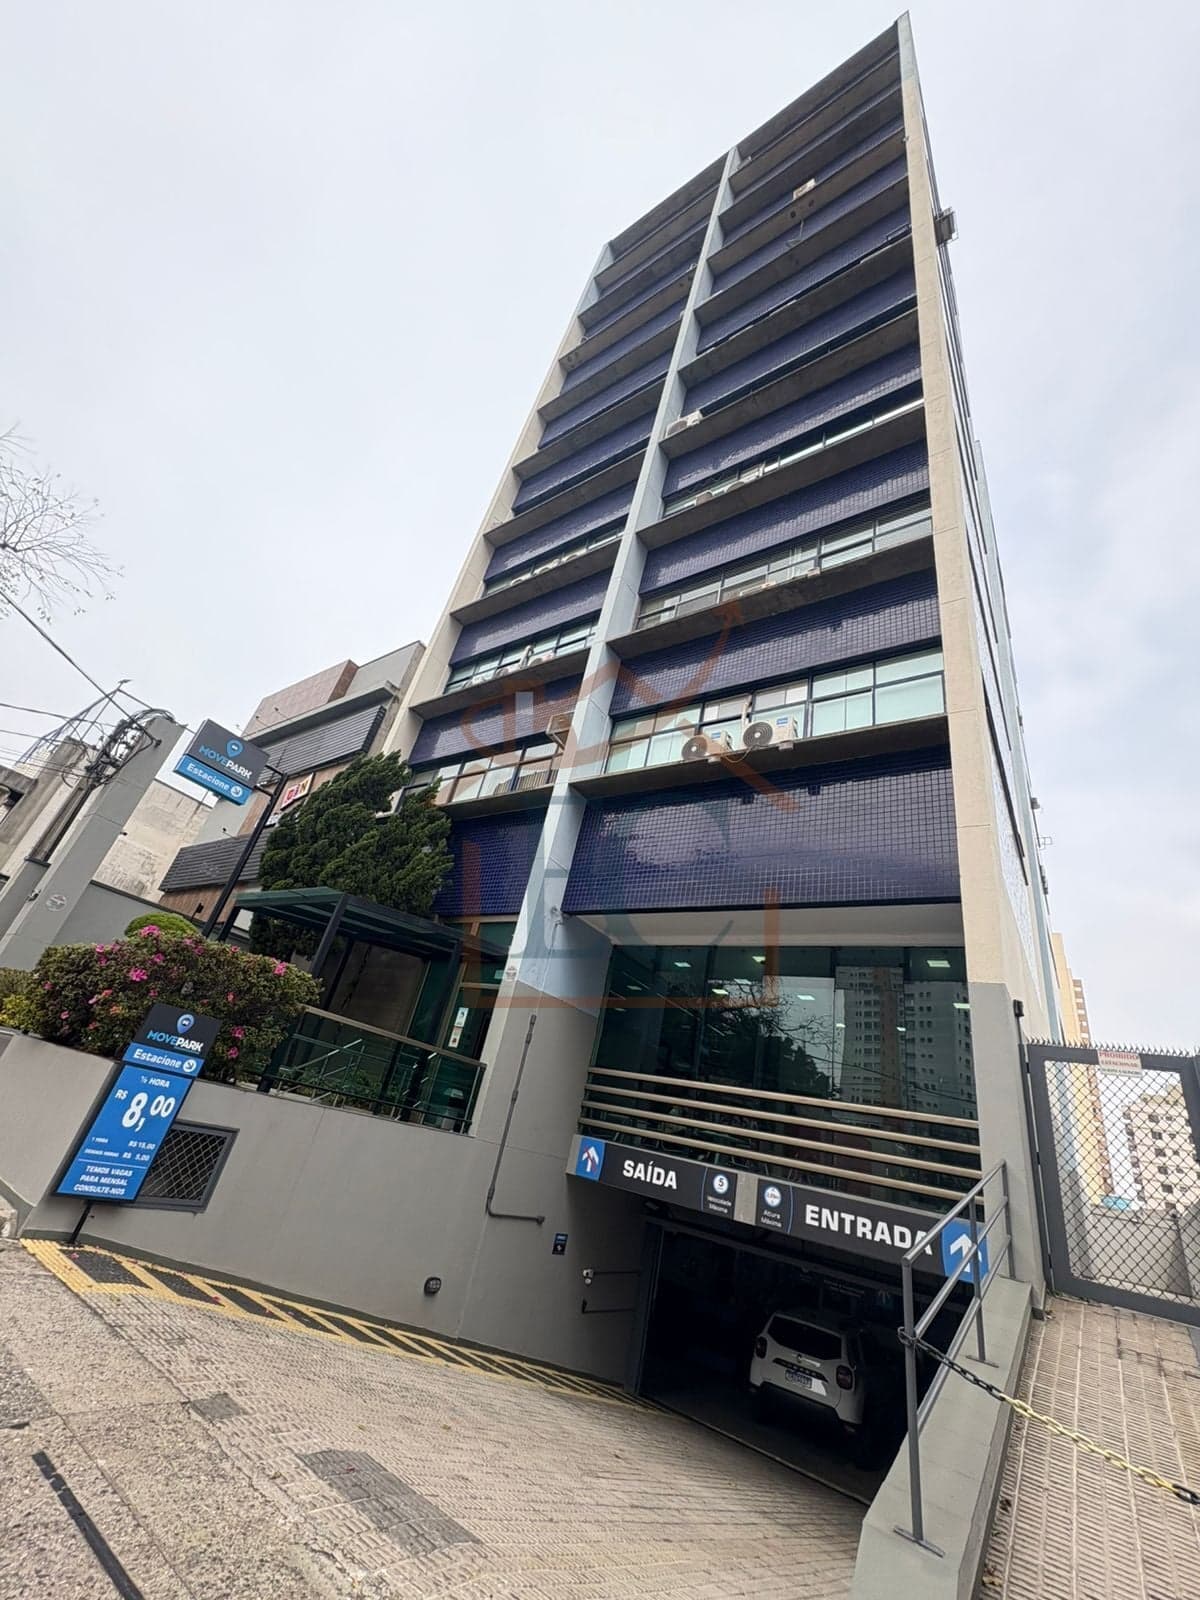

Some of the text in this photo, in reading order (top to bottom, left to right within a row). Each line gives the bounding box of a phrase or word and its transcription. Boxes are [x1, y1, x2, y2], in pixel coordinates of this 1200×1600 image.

[199, 745, 253, 780] MOVEPARK
[186, 762, 231, 792] Estacione
[147, 1030, 204, 1051] MOVEPARK
[133, 1048, 182, 1069] Estacione
[148, 1077, 170, 1088] HORA
[114, 1089, 128, 1100] R$
[86, 1165, 133, 1177] TEMOS VAGAS
[622, 1160, 678, 1190] SAÍDA
[79, 1174, 128, 1187] PARA MENSAL
[718, 1177, 725, 1187] 5
[73, 1183, 126, 1196] CONSULTE-NOS
[805, 1203, 933, 1256] ENTRADA
